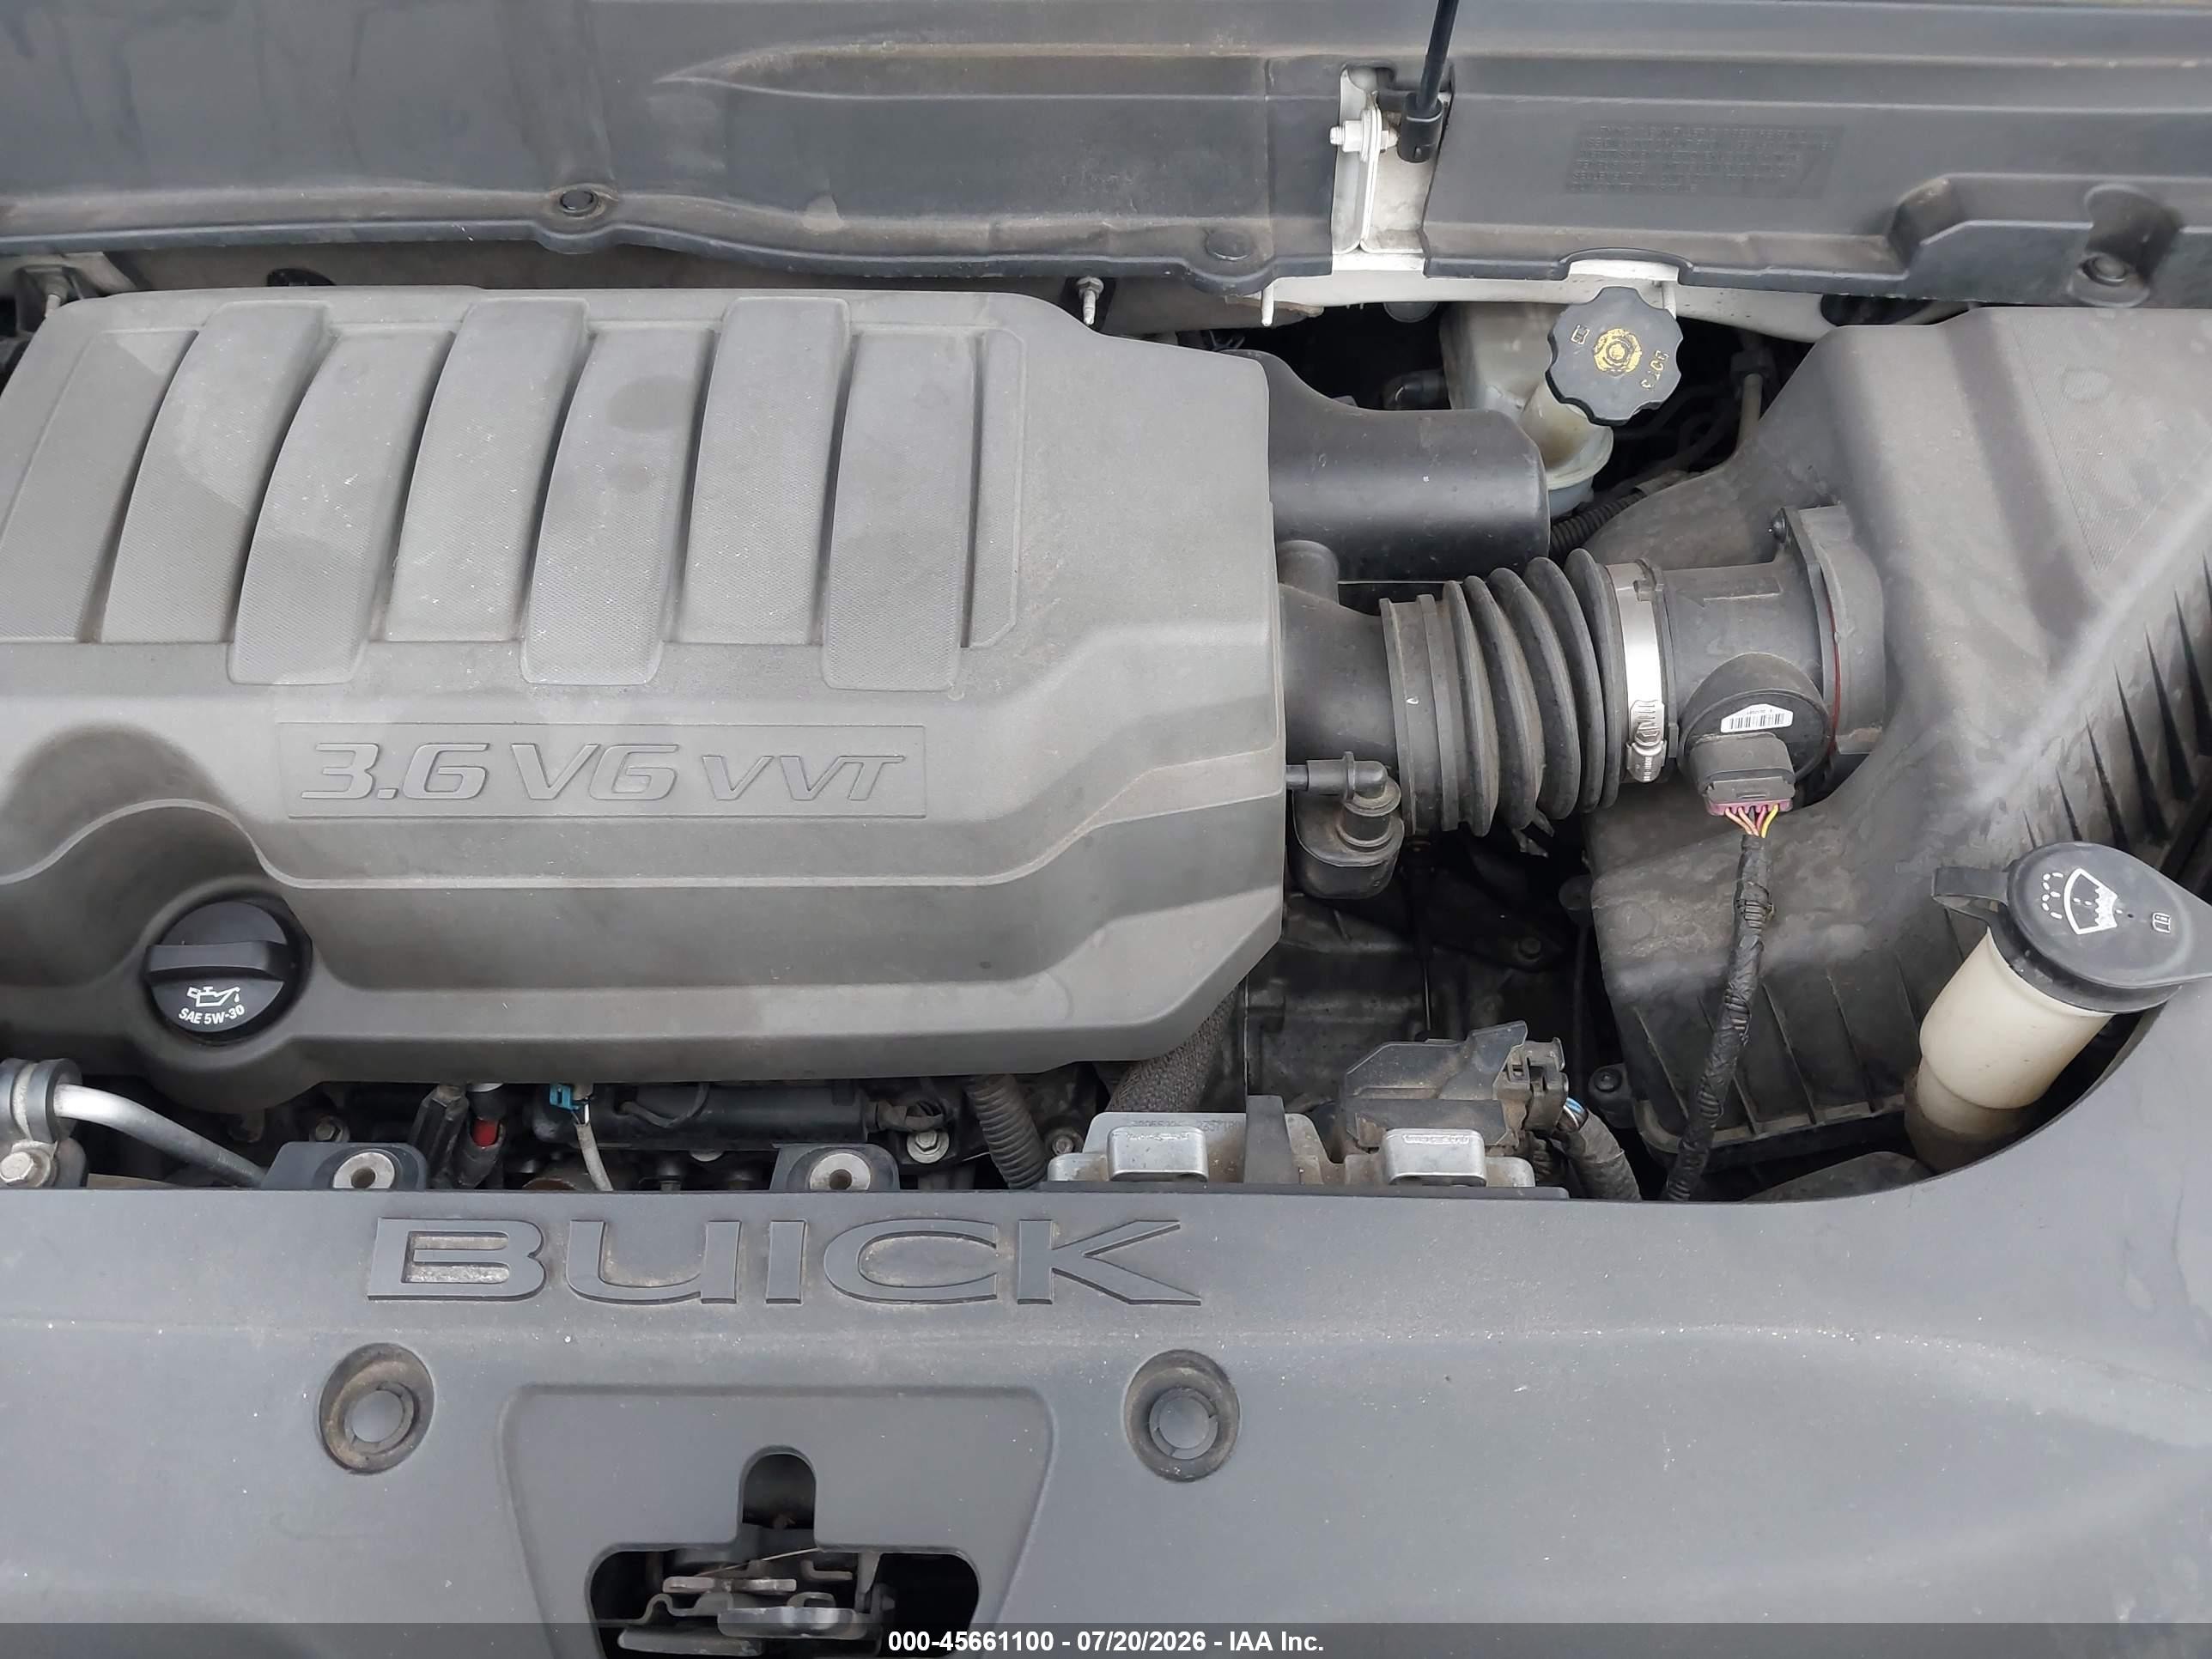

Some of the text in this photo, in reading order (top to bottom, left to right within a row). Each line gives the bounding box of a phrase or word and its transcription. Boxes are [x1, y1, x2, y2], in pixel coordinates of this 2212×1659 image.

[301, 743, 907, 801] 3.6 V6 VVT
[178, 1004, 246, 1024] SAE 5W-30
[367, 1217, 1202, 1305] BUICK
